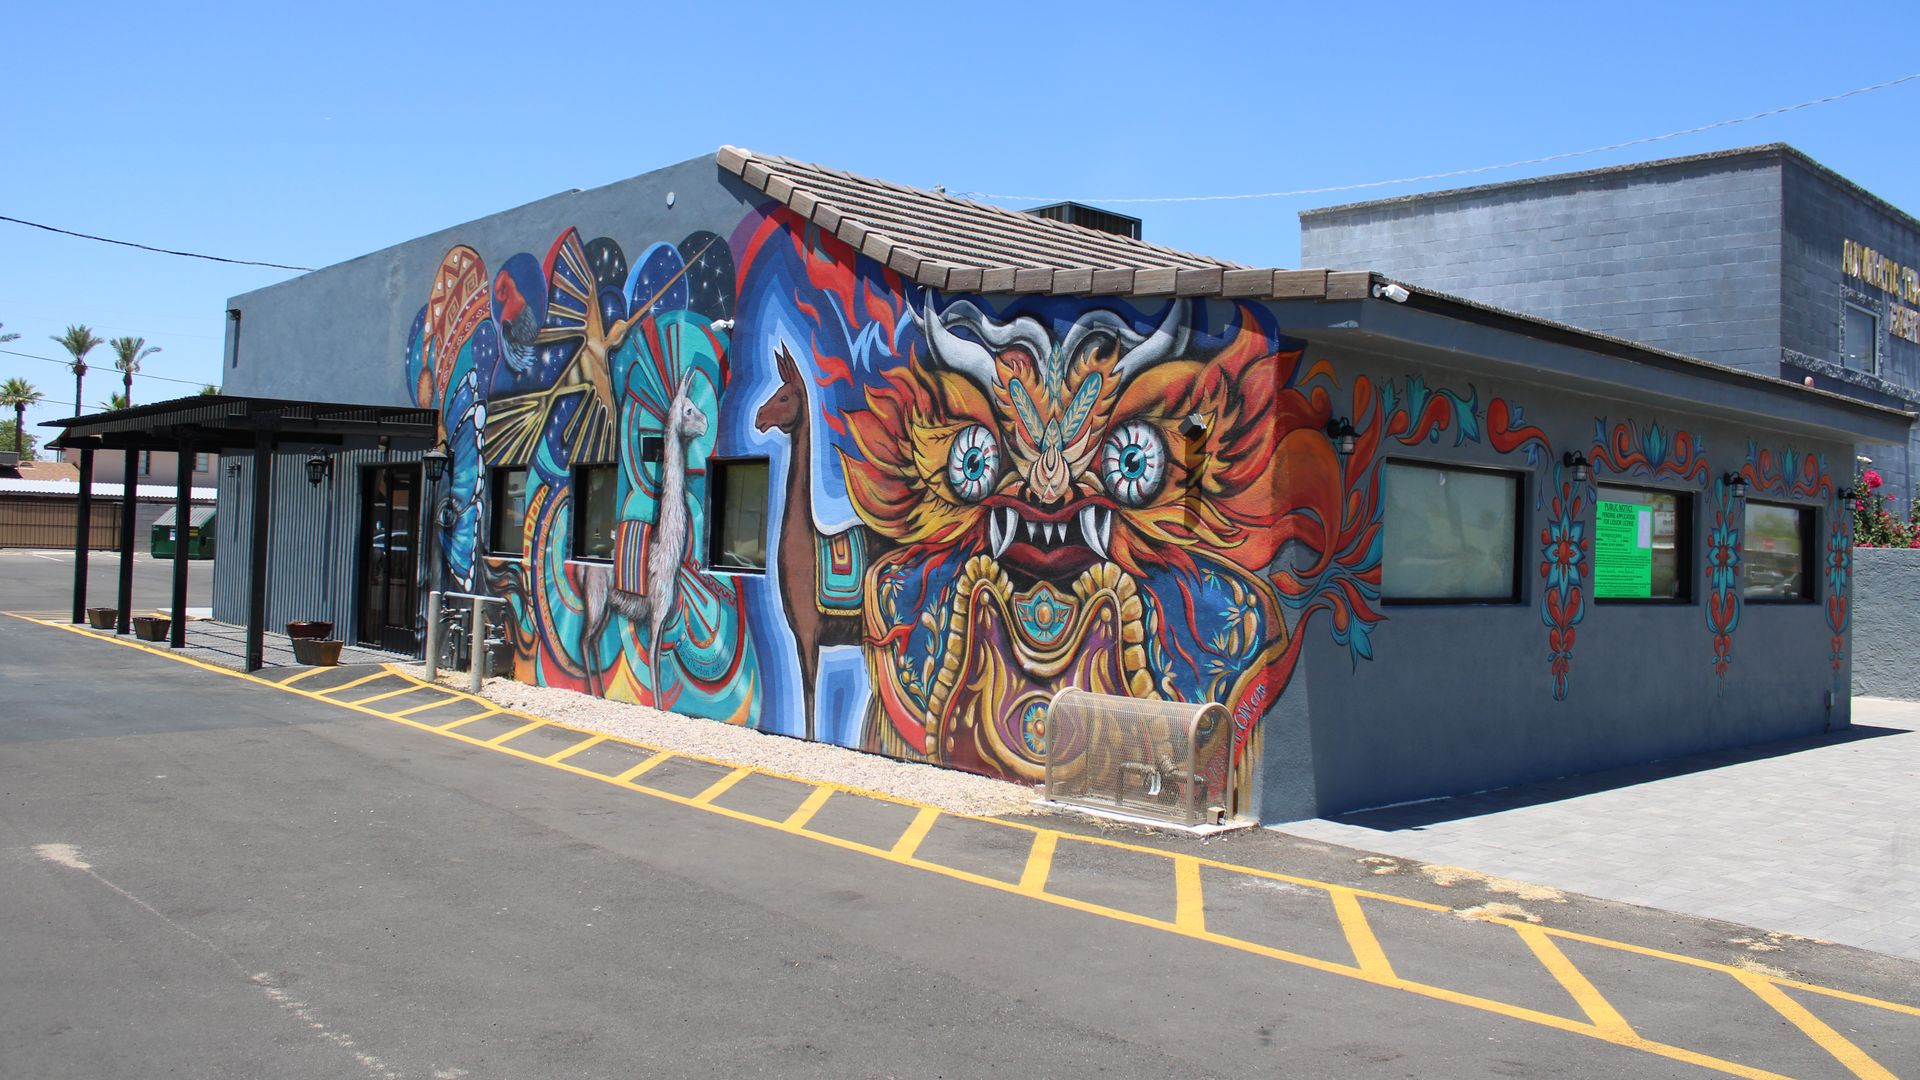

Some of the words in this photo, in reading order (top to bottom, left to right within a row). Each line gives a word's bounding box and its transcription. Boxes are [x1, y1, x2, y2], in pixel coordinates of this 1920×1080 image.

[1842, 239, 1901, 295] AUTOMATIC
[1604, 503, 1618, 511] PUBLIC
[1618, 504, 1632, 513] NOTICE
